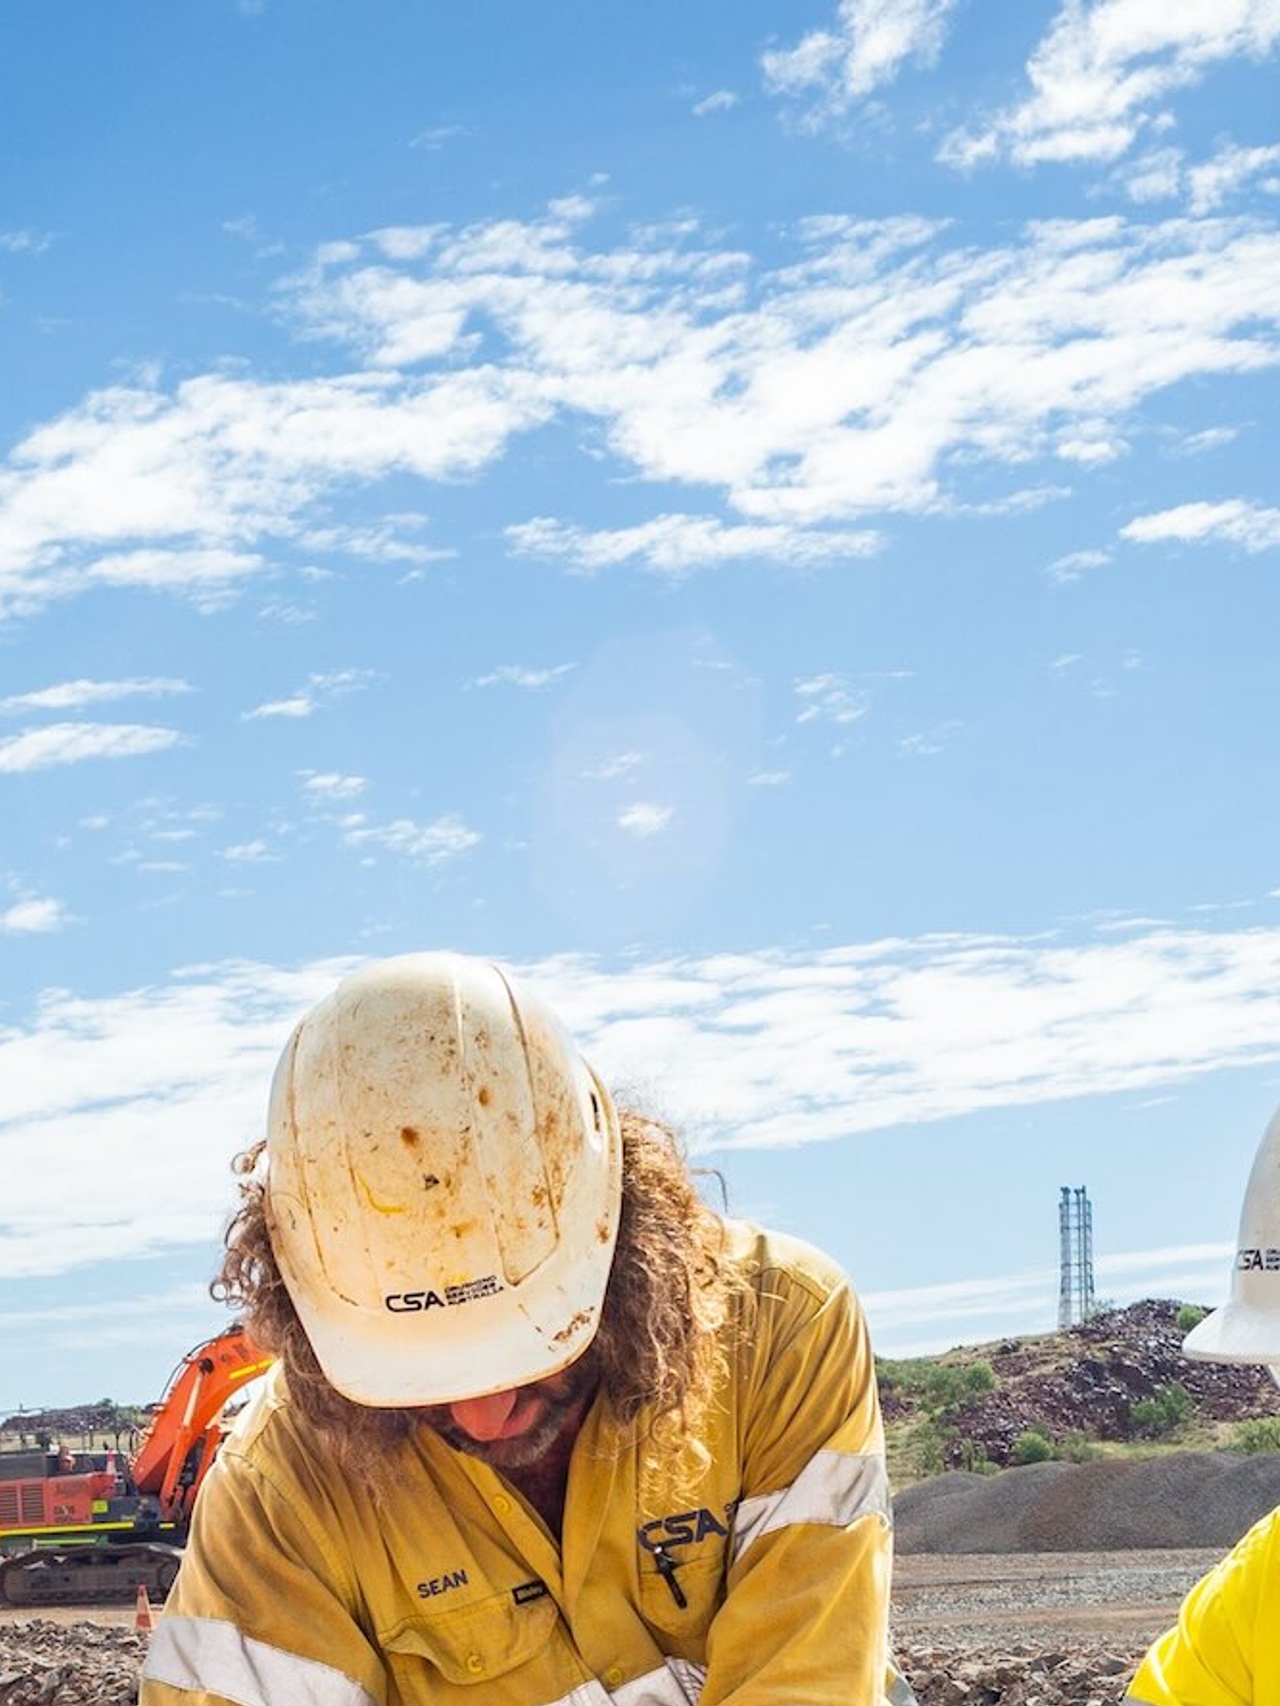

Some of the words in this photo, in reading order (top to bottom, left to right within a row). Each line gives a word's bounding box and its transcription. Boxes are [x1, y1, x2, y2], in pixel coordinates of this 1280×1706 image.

[385, 1290, 445, 1312] CSA
[638, 1507, 728, 1554] CSA
[417, 1569, 469, 1599] SEAN
